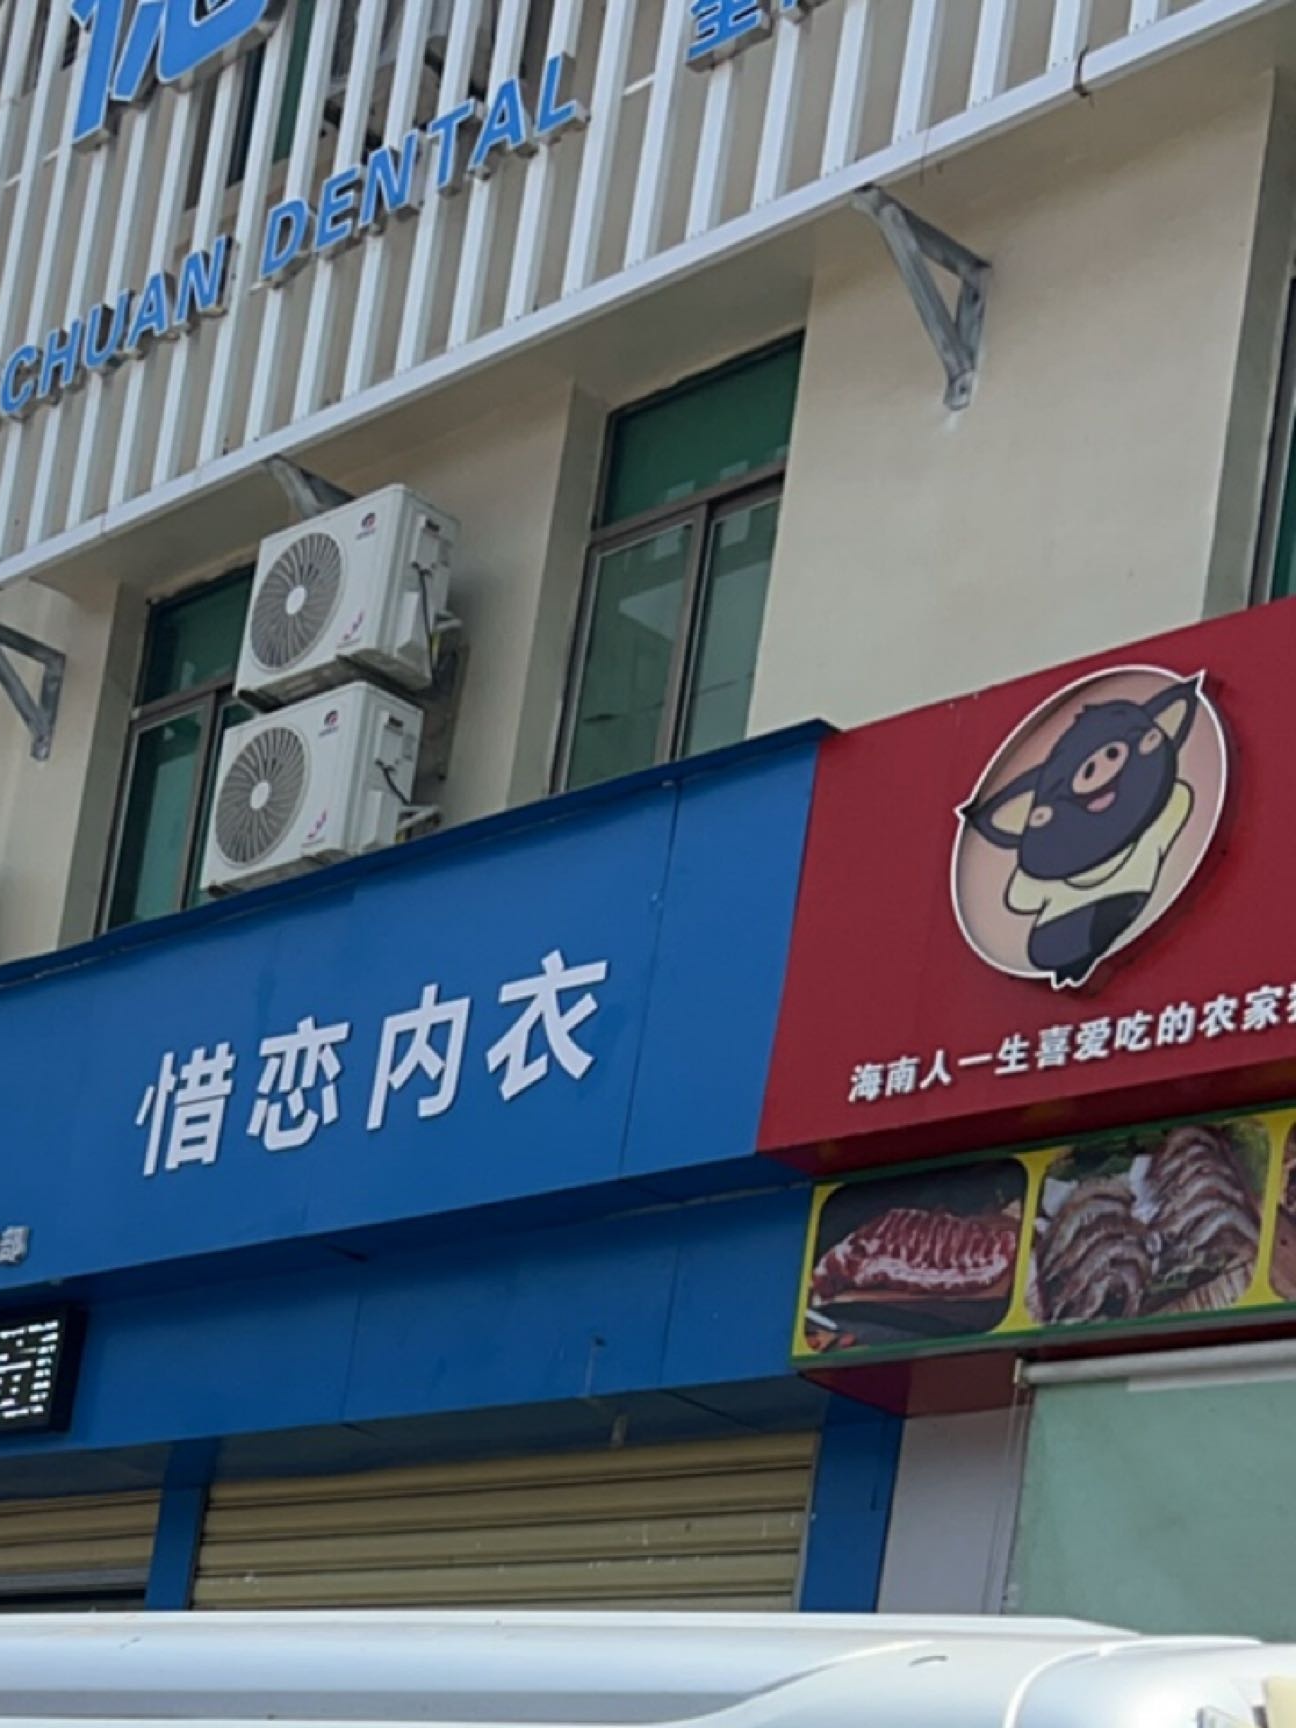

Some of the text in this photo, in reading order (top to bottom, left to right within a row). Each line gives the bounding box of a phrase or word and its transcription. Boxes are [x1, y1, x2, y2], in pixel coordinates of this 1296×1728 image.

[261, 53, 580, 281] DENTAL
[134, 949, 609, 1177] 惜恋内衣
